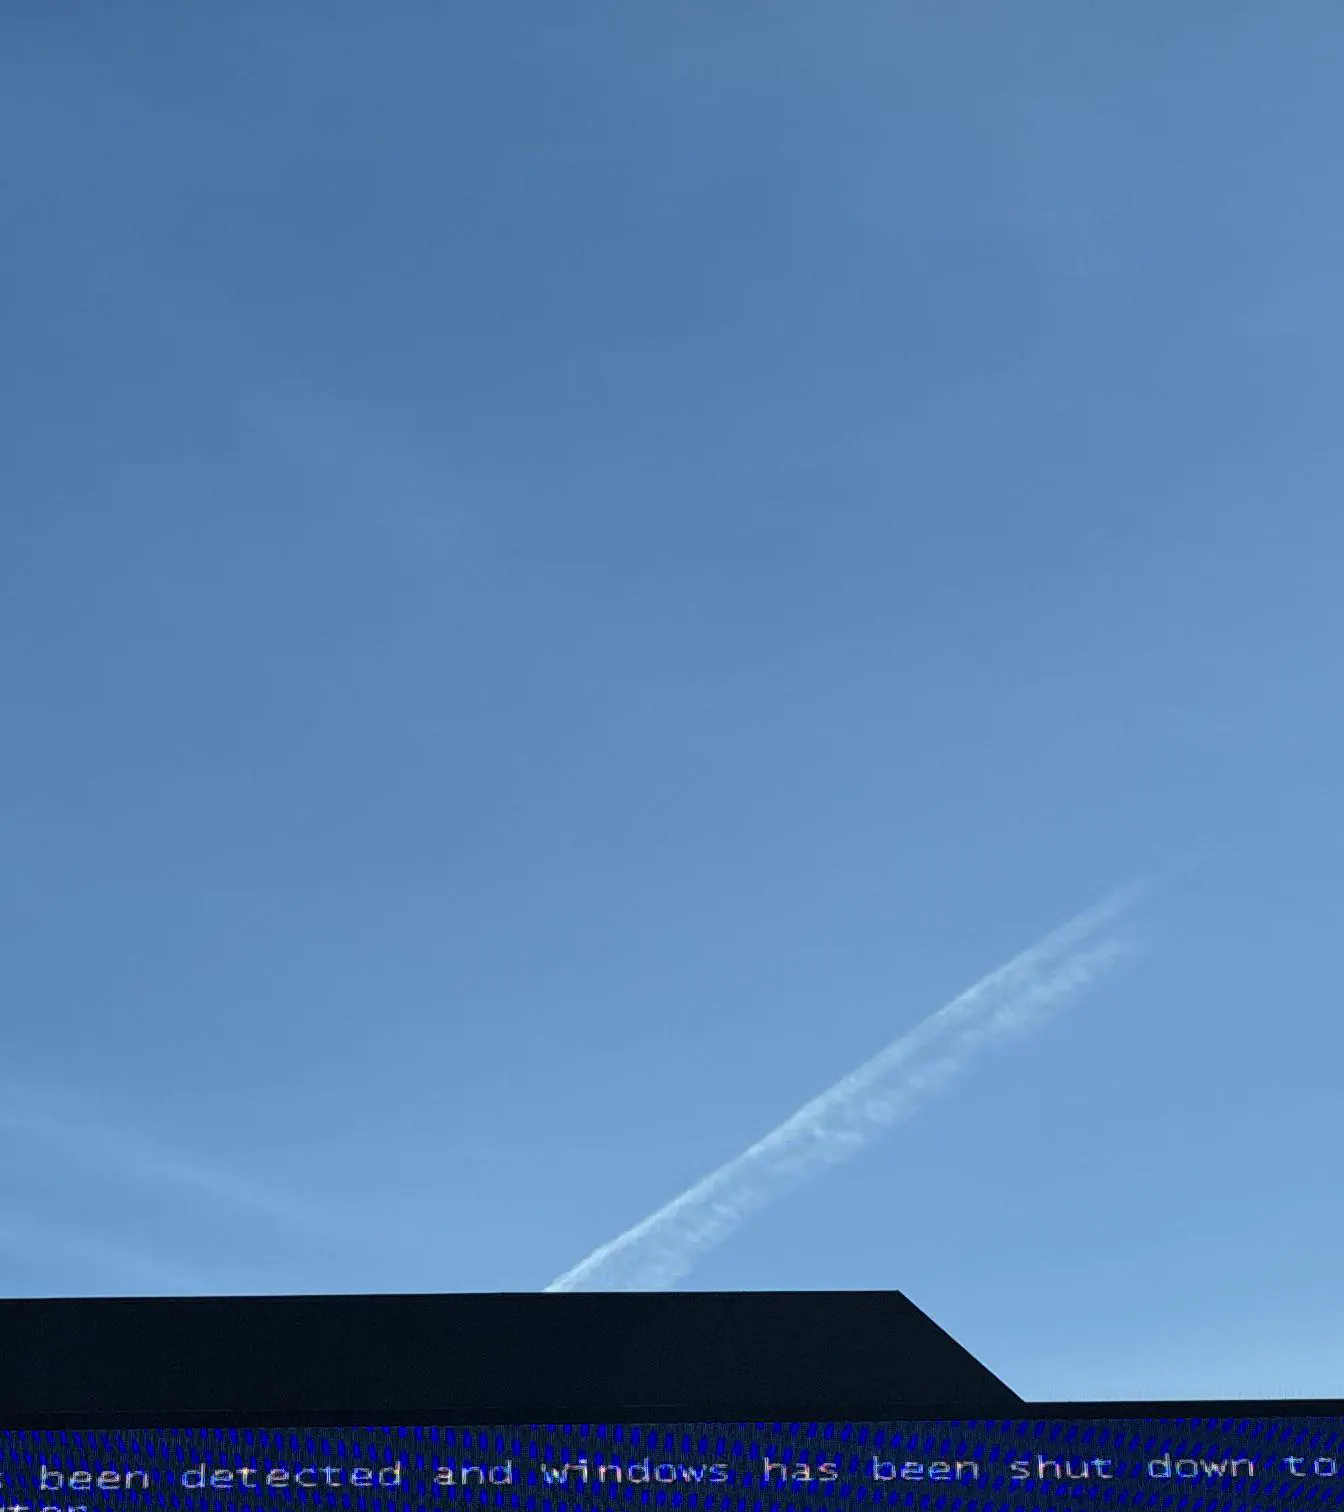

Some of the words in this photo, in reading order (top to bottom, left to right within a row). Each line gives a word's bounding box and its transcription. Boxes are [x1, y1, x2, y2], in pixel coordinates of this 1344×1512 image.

[39, 1463, 149, 1491] been
[182, 1462, 401, 1489] detected
[436, 1461, 512, 1486] and
[541, 1459, 726, 1484] windows
[764, 1457, 838, 1482] has
[873, 1456, 978, 1481] been
[1011, 1454, 1114, 1479] shut
[1149, 1455, 1255, 1477] down
[1288, 1457, 1335, 1477] to
